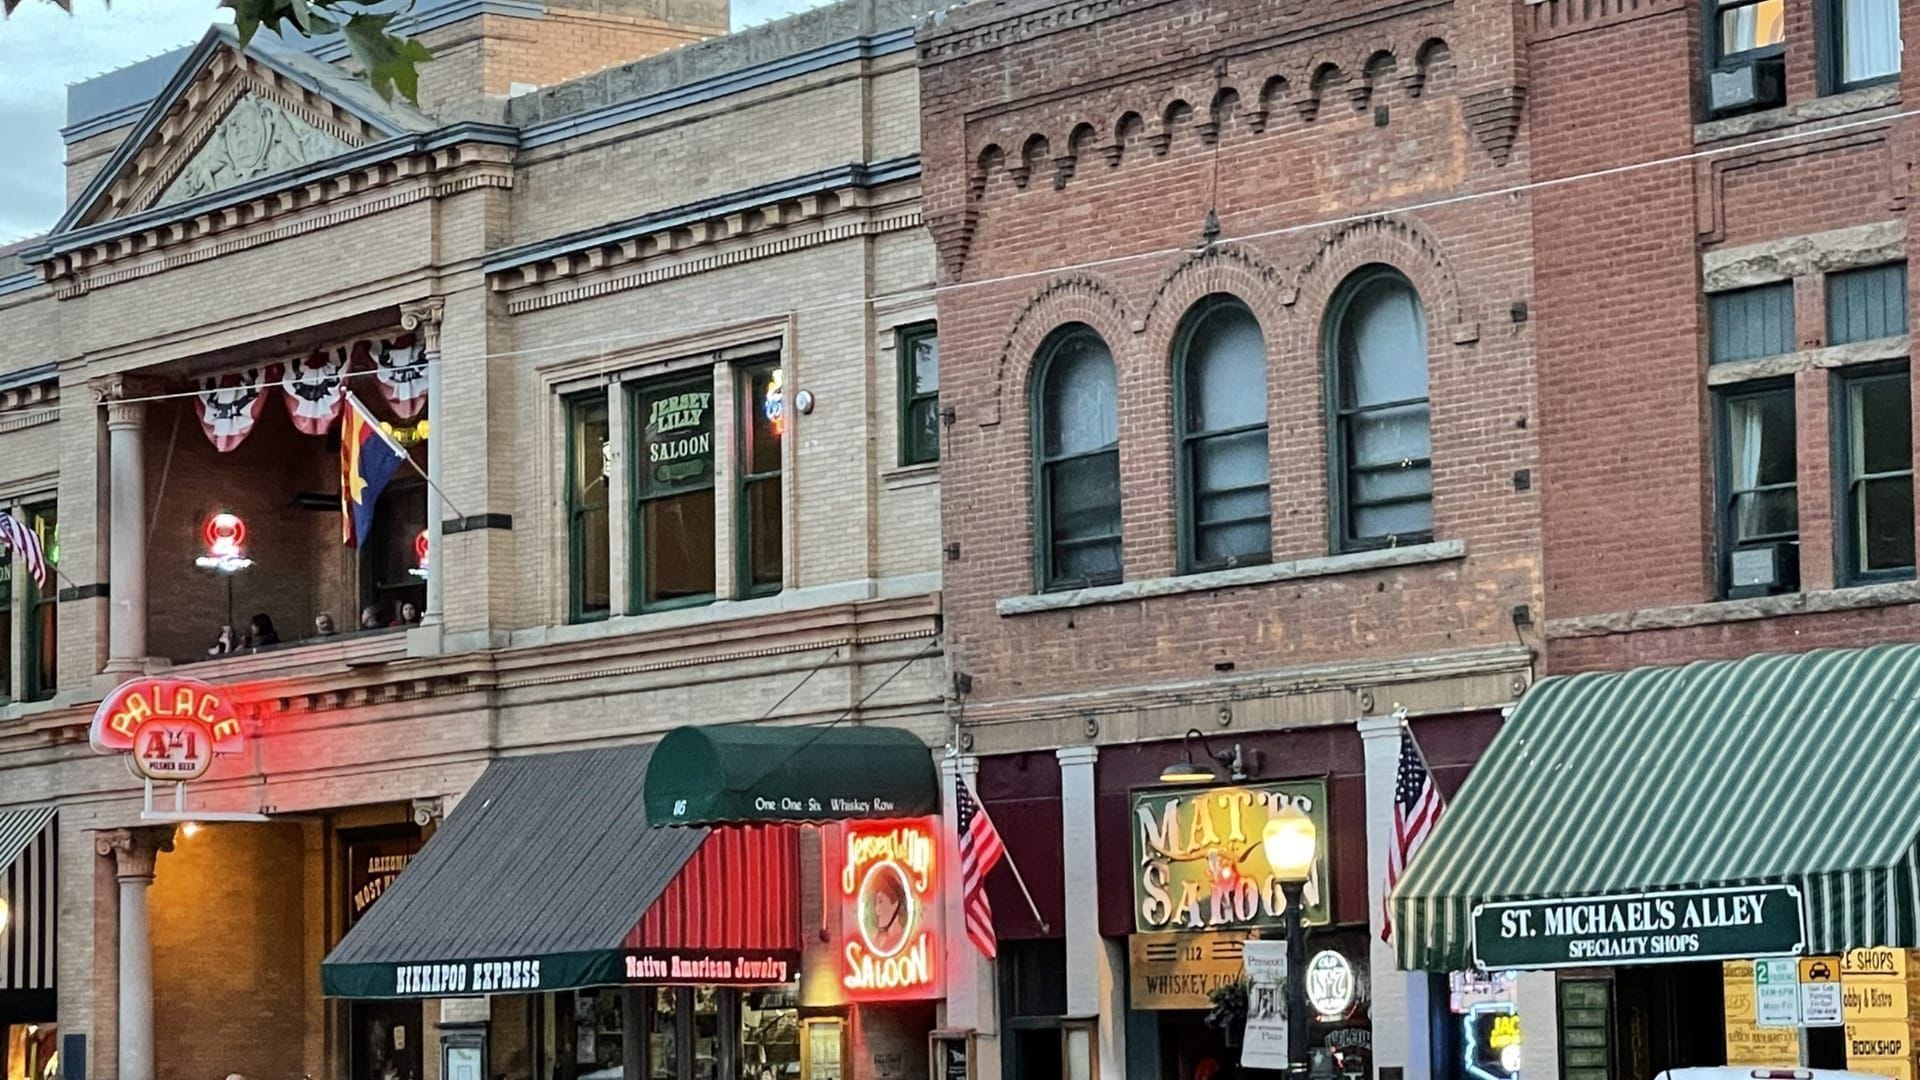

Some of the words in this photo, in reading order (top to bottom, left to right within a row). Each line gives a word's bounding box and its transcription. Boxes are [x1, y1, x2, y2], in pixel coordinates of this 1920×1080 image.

[650, 392, 711, 425] JERSEY
[657, 408, 703, 433] LILLY
[650, 432, 710, 463] SALOON
[111, 685, 241, 741] PALACE
[150, 762, 176, 771] PILSNER
[178, 762, 196, 771] BEER
[755, 797, 777, 811] One
[781, 797, 802, 811] One
[808, 798, 822, 811] Six
[830, 798, 870, 813] Whiskey
[873, 798, 895, 811] Row
[354, 877, 382, 912] MOST
[1142, 857, 1320, 926] SALOON
[1501, 909, 1537, 937] ST.
[1543, 898, 1675, 935] MICHAEL'S
[1681, 894, 1767, 929] ALLEY
[1185, 947, 1202, 961] 112
[1568, 936, 1648, 958] SPECIALTY
[1650, 933, 1699, 954] SHOPS
[625, 955, 668, 978] Native
[671, 955, 732, 978] American
[734, 956, 787, 982] Jewelry
[843, 933, 930, 989] SALOON
[1757, 965, 1767, 981] 2
[1857, 951, 1894, 970] SHOPS
[472, 960, 540, 990] EXPRESS
[1146, 974, 1208, 995] WHISKEY
[1863, 988, 1869, 1008] &
[1870, 988, 1893, 1008] Bistro
[1852, 1040, 1902, 1056] BOOKSHOP
